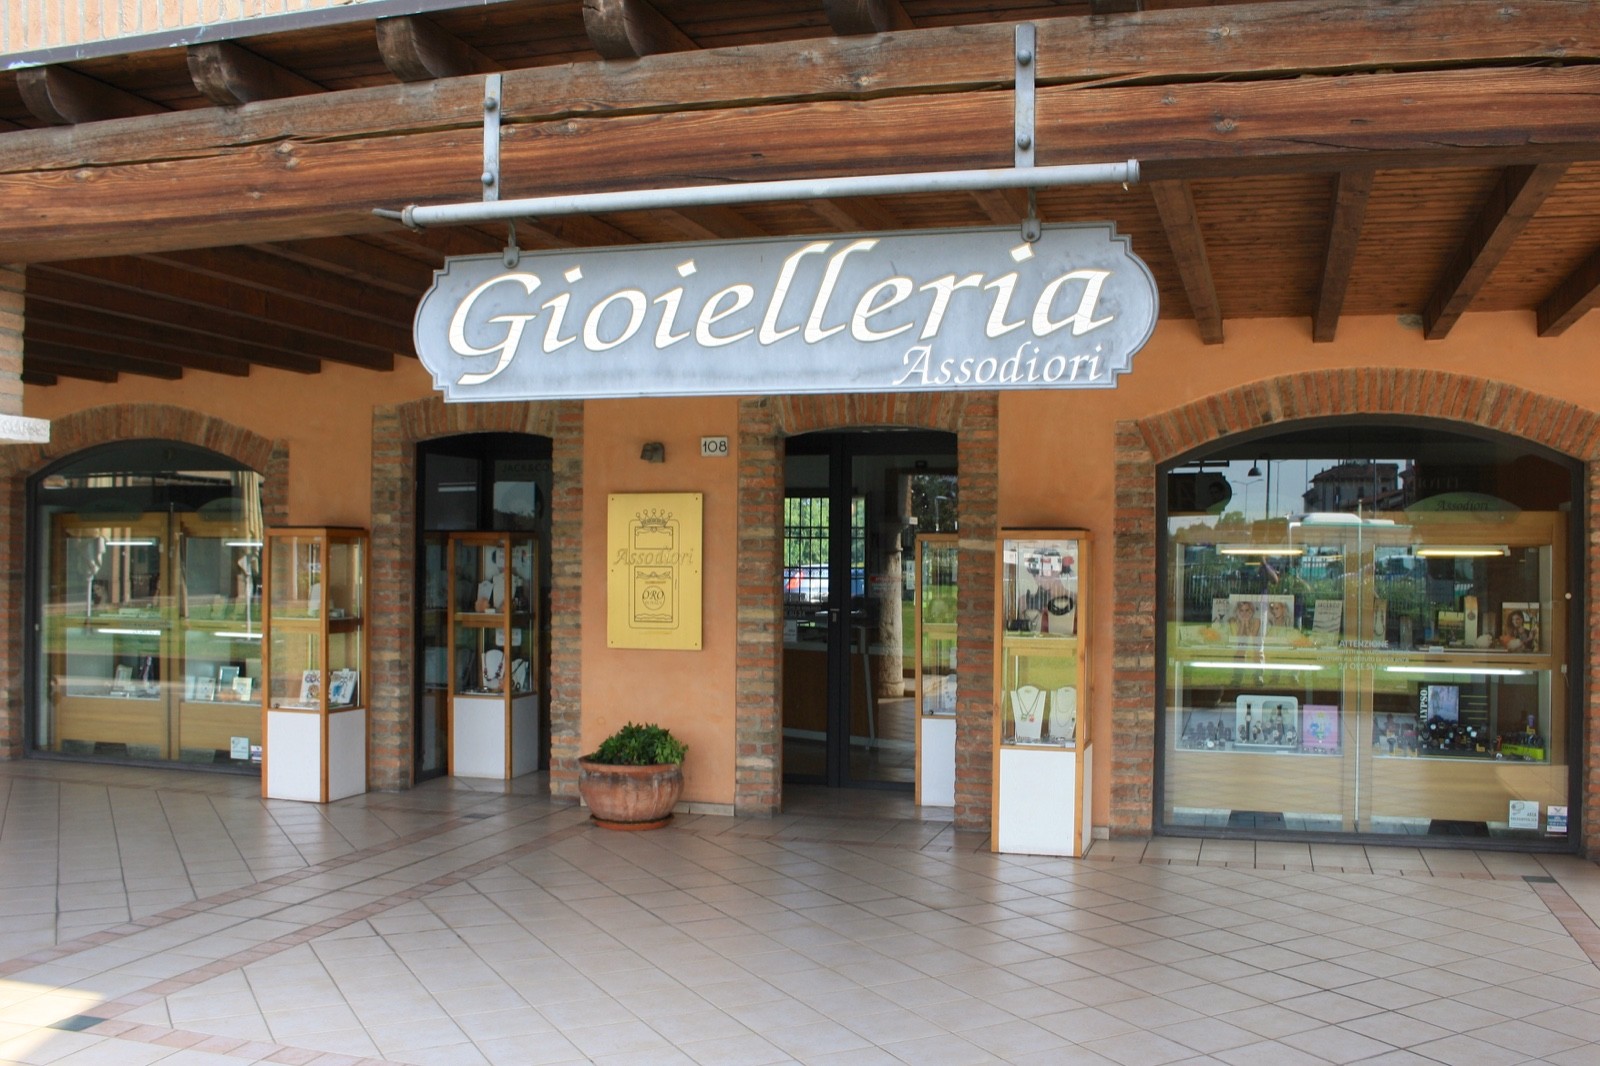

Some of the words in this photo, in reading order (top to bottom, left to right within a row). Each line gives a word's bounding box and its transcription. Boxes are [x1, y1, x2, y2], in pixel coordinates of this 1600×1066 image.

[447, 238, 1115, 387] Gioielleria
[891, 342, 1105, 387] Assodiori
[702, 440, 727, 453] 108
[1436, 499, 1489, 512] Assodiori
[612, 547, 694, 566] Assodiori
[1338, 640, 1389, 649] ATTENZIONE
